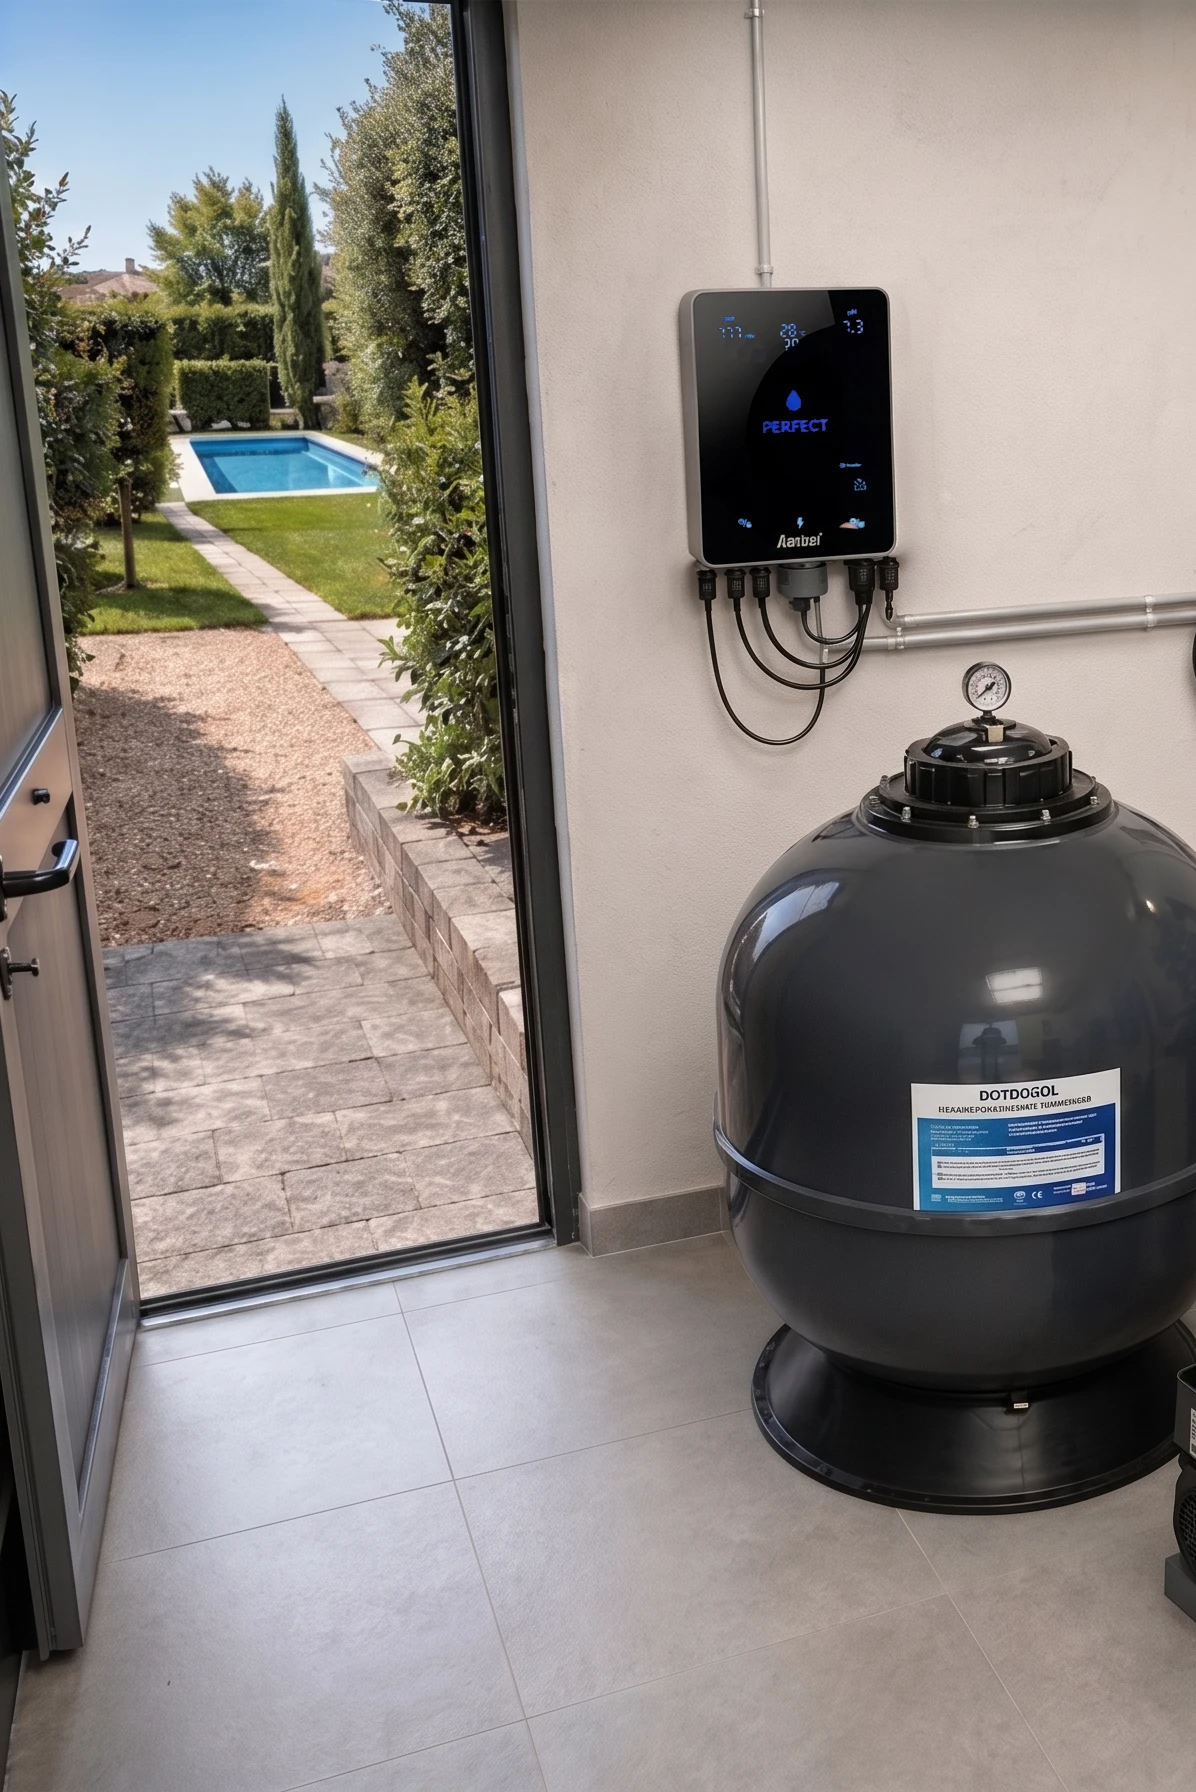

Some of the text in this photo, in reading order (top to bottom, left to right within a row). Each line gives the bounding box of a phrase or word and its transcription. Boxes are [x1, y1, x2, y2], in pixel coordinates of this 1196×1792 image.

[780, 323, 796, 337] 28
[843, 319, 863, 334] 7.3
[763, 419, 828, 433] PERFECT
[979, 1085, 1059, 1101] DOTDOGOL
